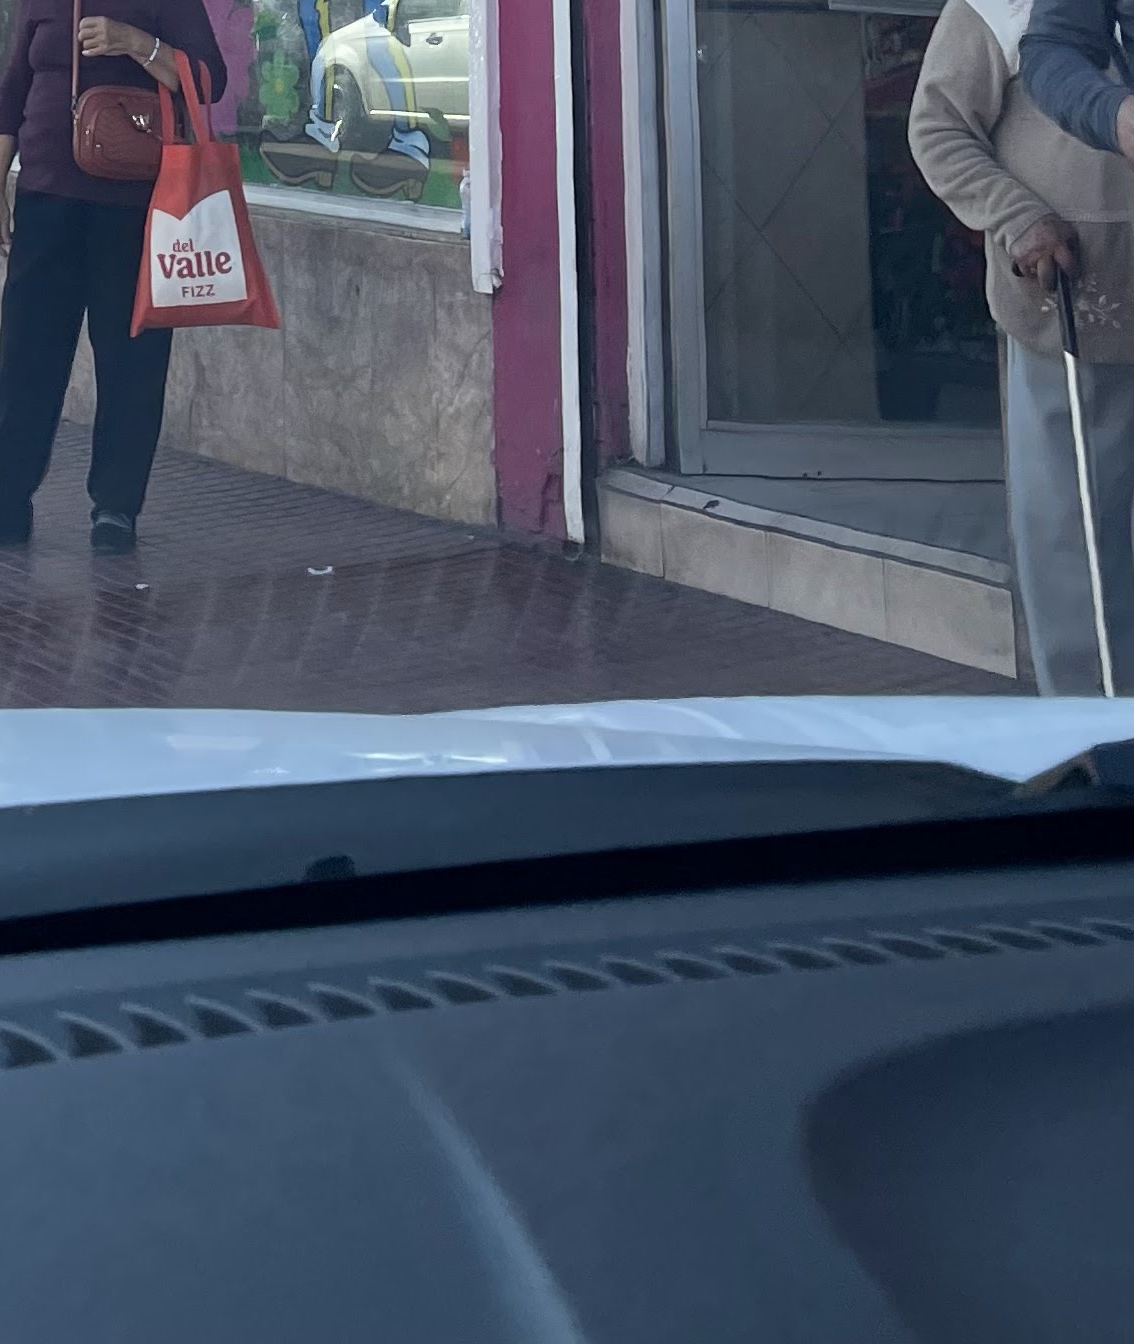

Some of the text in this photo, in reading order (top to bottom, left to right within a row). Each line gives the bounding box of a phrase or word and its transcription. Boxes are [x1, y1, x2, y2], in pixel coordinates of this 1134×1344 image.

[172, 238, 194, 252] del
[157, 251, 232, 279] Valle
[181, 284, 216, 298] FIZZ
